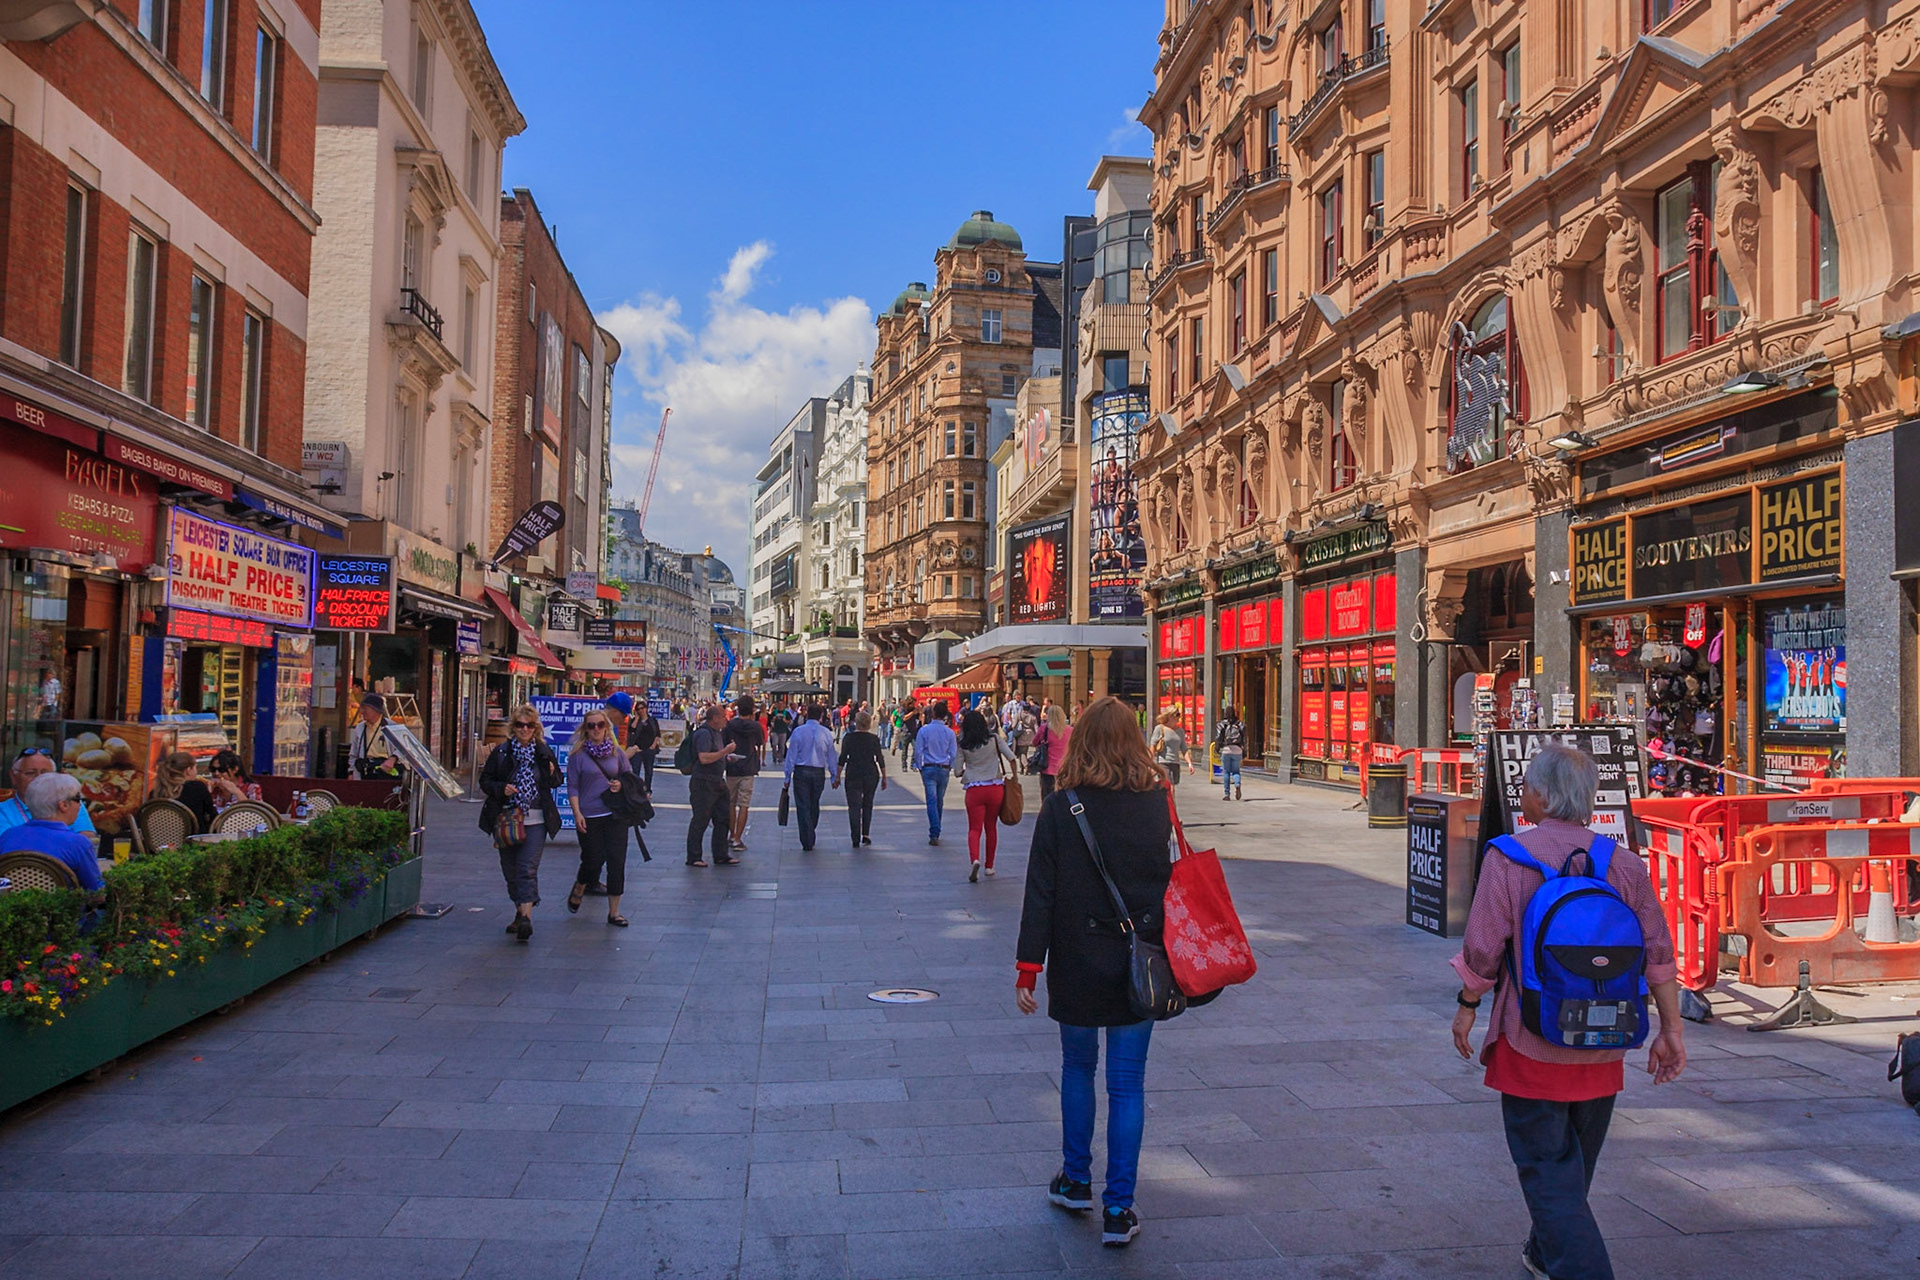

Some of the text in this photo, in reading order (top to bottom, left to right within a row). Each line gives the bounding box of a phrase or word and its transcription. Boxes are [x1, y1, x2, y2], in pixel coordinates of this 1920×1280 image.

[15, 401, 45, 428] BEER
[302, 443, 340, 452] ANBOURN
[316, 452, 334, 461] WC2
[65, 449, 139, 497] BAGELS
[120, 445, 223, 495] BAGELS BAKED ON PREMISES
[68, 492, 135, 524] KEBABS & PIZZA
[1762, 477, 1840, 530] HALF
[263, 499, 325, 533] THE HALF PRICE BOOTH
[527, 510, 553, 530] HALF
[519, 517, 547, 539] PRICE
[69, 535, 130, 560] TO TAKE AWAY
[183, 519, 230, 553] LEICESTER
[233, 534, 263, 562] SQUARE
[266, 543, 280, 569] BOX
[283, 550, 307, 574] OFFICE
[1305, 520, 1388, 564] CRYSTAL ROOMS
[1575, 525, 1626, 563] HALF
[1635, 526, 1751, 569] SOUVENIRS
[1762, 519, 1840, 566] PRICE
[189, 550, 293, 600] HALF PRICE
[321, 560, 388, 572] LEICESTER
[1575, 558, 1626, 593] PRICE
[1766, 564, 1798, 576] DISCOUNTED
[1797, 560, 1820, 571] THEATRE
[328, 573, 380, 586] SQUARE
[570, 580, 595, 589] OPEN
[171, 580, 224, 602] DISCOUNT
[229, 590, 267, 613] THEATRE
[271, 600, 304, 618] TICKETS
[1019, 601, 1056, 614] RED LIGHTS
[1335, 587, 1362, 610] CRYSTAL
[315, 601, 389, 617] & DISCOUNT
[552, 606, 577, 616] HALF
[1101, 606, 1115, 614] JUNE
[329, 616, 379, 628] TICKETS
[552, 614, 577, 624] PRICE
[1337, 609, 1360, 630] ROOMS
[1788, 612, 1808, 631] BEST
[1809, 610, 1830, 629] WEST
[1686, 629, 1704, 641] OFF
[1773, 632, 1807, 650] MUSICAL
[1807, 631, 1823, 648] FOR
[1615, 640, 1629, 650] OFF
[535, 700, 604, 715] HALF PRIC
[1333, 700, 1344, 710] FREE
[1778, 695, 1840, 718] JERSEY BOYS
[1309, 712, 1318, 722] BIG
[1597, 763, 1623, 772] FICIAL
[1764, 754, 1815, 771] THRILLER
[1598, 772, 1620, 780] GENT
[1765, 774, 1784, 783] TICKETS
[1792, 802, 1829, 815] ranServ
[1599, 814, 1616, 824] HAT
[1411, 825, 1442, 853] HALF
[1410, 850, 1442, 881] PRICE
